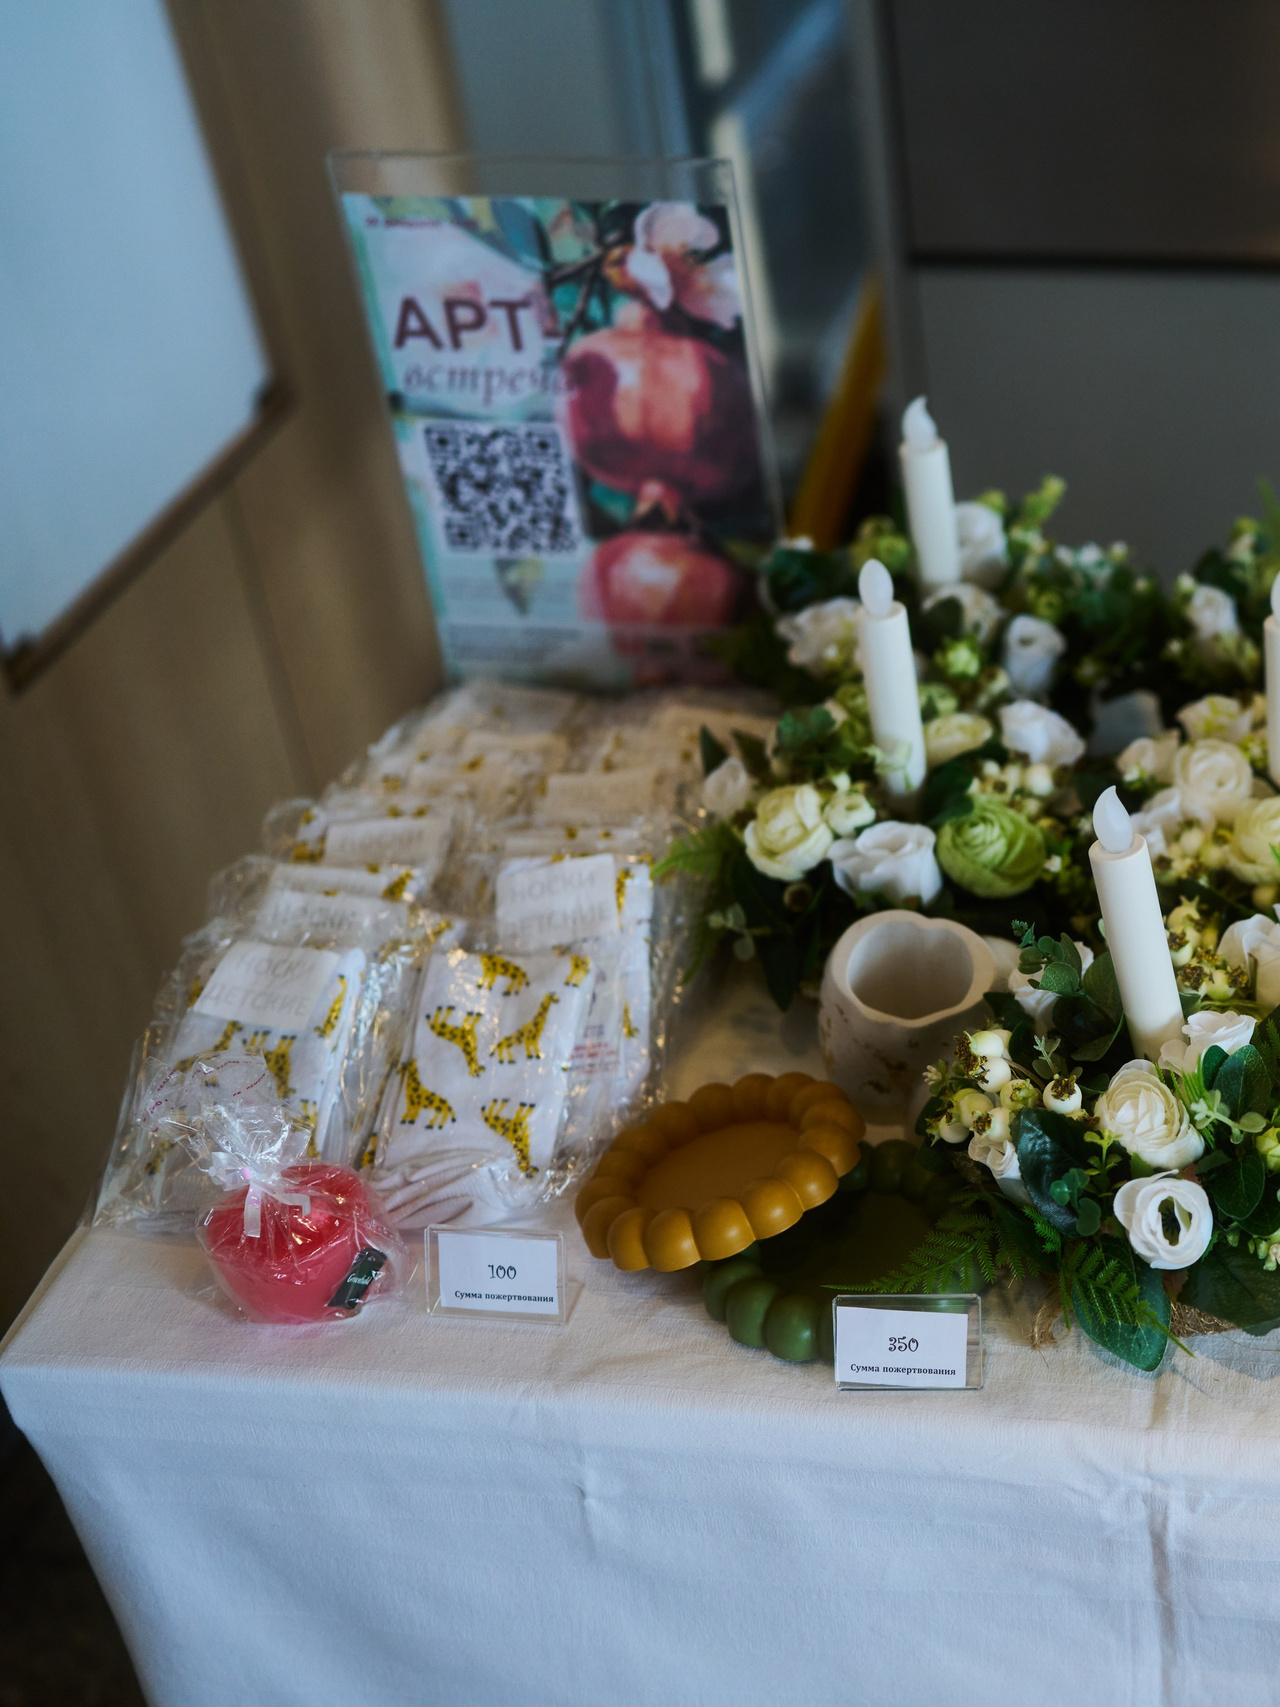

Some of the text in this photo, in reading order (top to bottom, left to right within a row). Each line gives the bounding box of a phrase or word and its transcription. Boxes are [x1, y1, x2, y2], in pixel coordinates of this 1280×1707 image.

[487, 1263, 517, 1280] 100
[454, 1290, 554, 1303] Сумма пожертвования
[888, 1335, 919, 1353] 350
[850, 1363, 956, 1376] Сумма пожертвования
